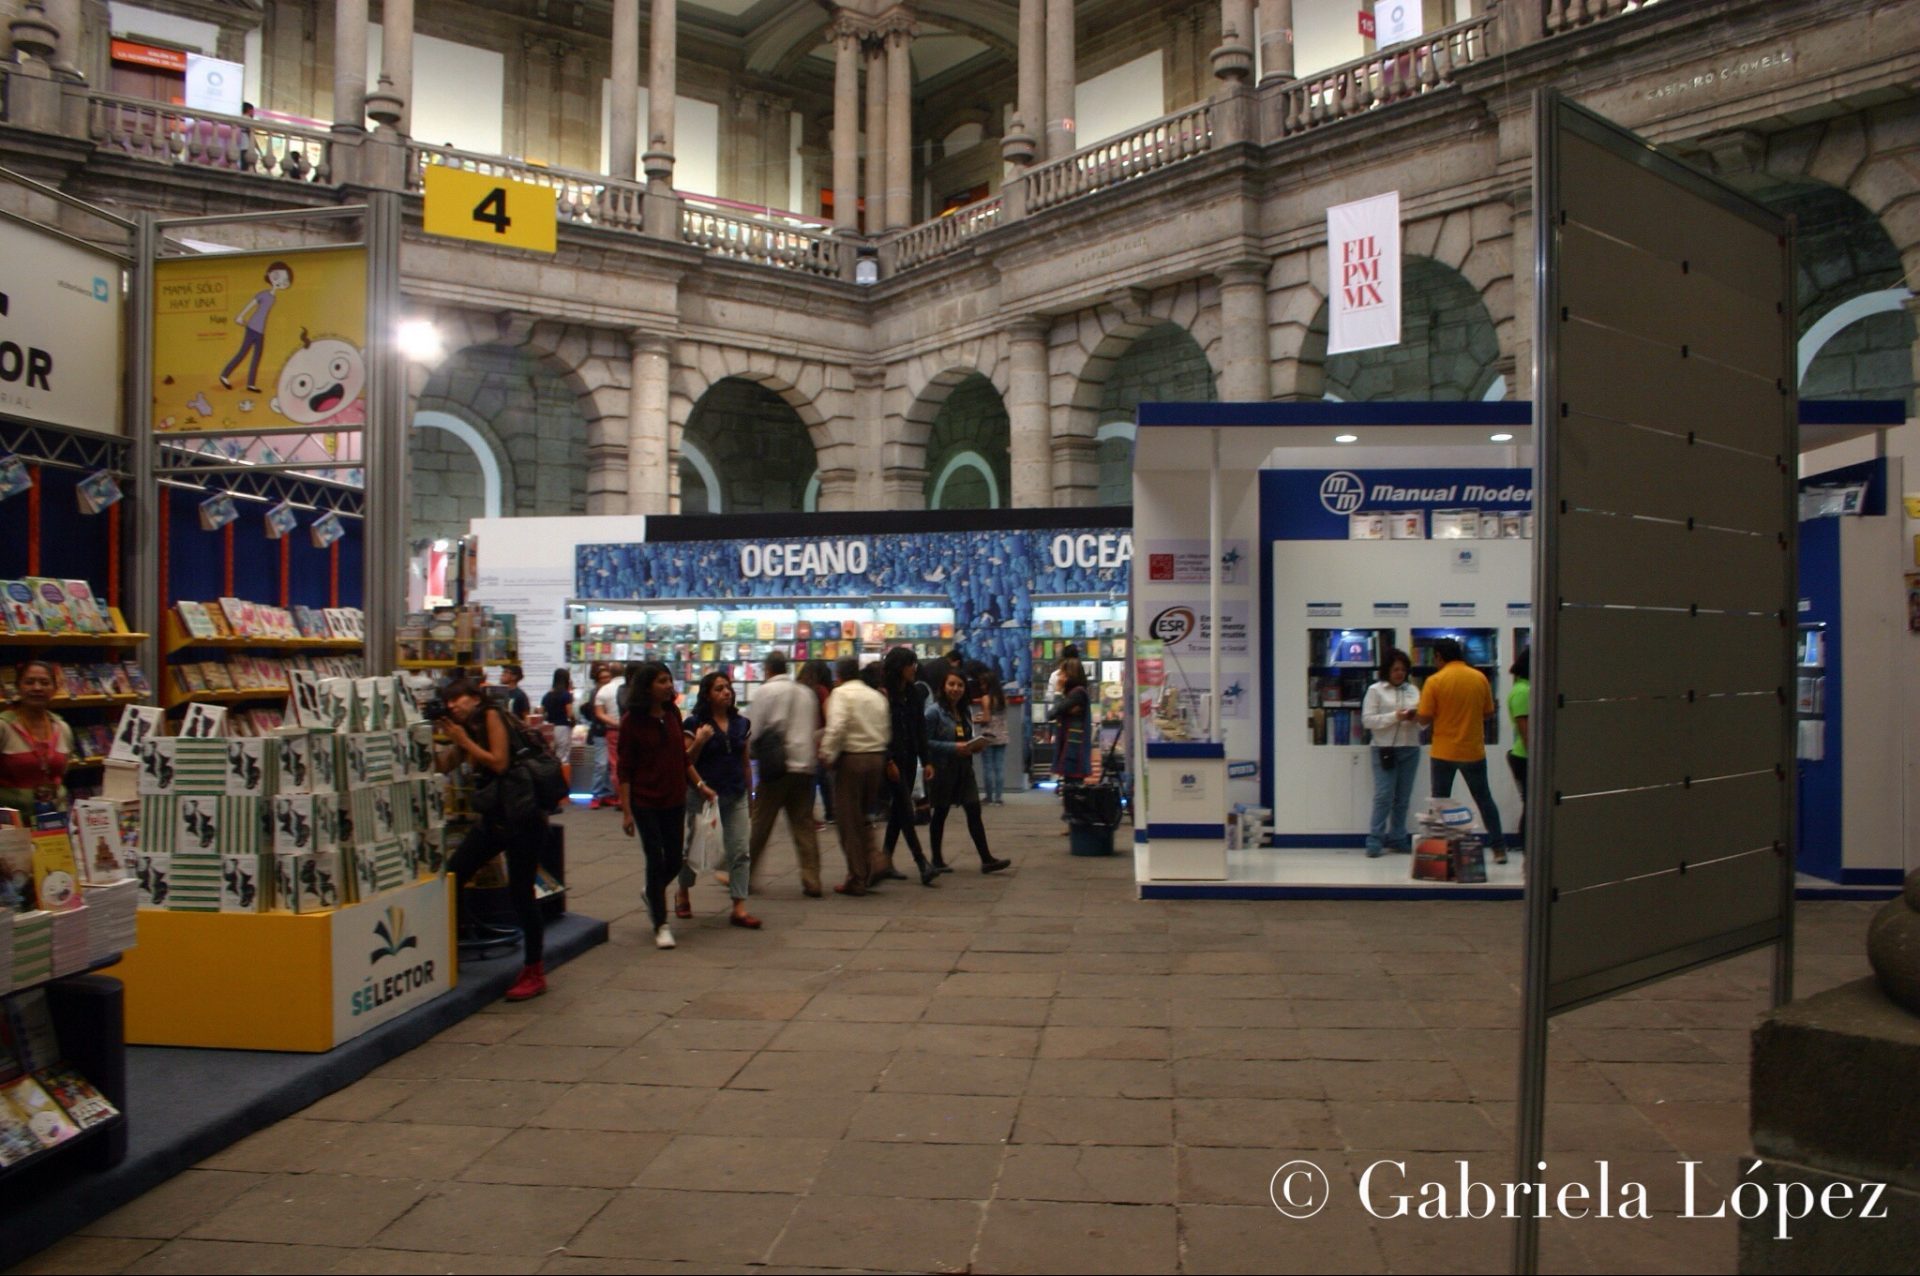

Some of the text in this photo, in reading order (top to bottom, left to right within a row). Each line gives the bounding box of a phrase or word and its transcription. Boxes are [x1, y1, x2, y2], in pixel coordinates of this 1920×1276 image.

[473, 188, 511, 234] 4
[1343, 236, 1381, 264] FIL
[1343, 259, 1379, 287] PM
[1342, 281, 1383, 310] MX
[1370, 485, 1457, 501] Manual
[741, 541, 867, 577] OCEANO
[1159, 620, 1185, 632] ESR
